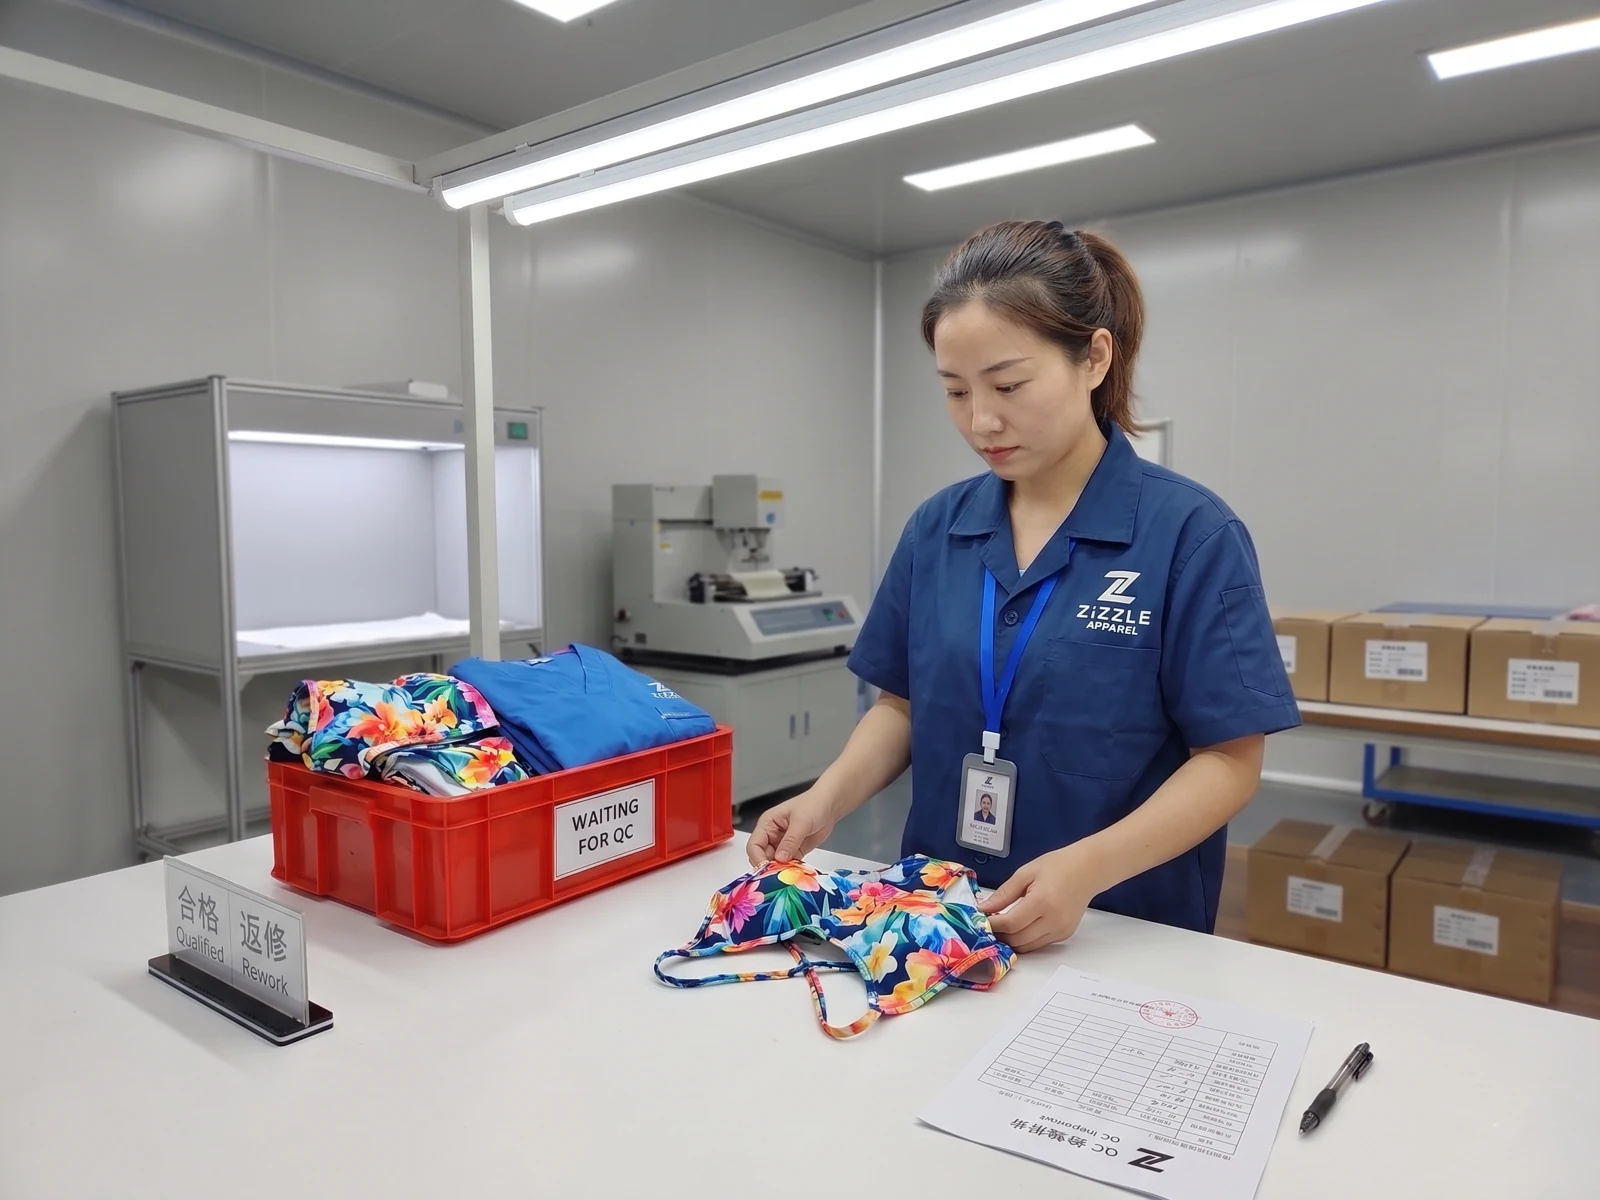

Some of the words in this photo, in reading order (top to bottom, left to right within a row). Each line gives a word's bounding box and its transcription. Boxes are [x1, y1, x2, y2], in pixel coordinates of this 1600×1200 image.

[1086, 621, 1138, 635] APPAREL
[572, 798, 638, 831] WAITING
[579, 832, 609, 855] FOR
[613, 824, 633, 844] QC
[178, 886, 219, 935] 合格
[176, 926, 224, 963] Qualified
[240, 911, 287, 962] 返修
[242, 957, 288, 996] Rework
[1091, 1143, 1118, 1157] QC
